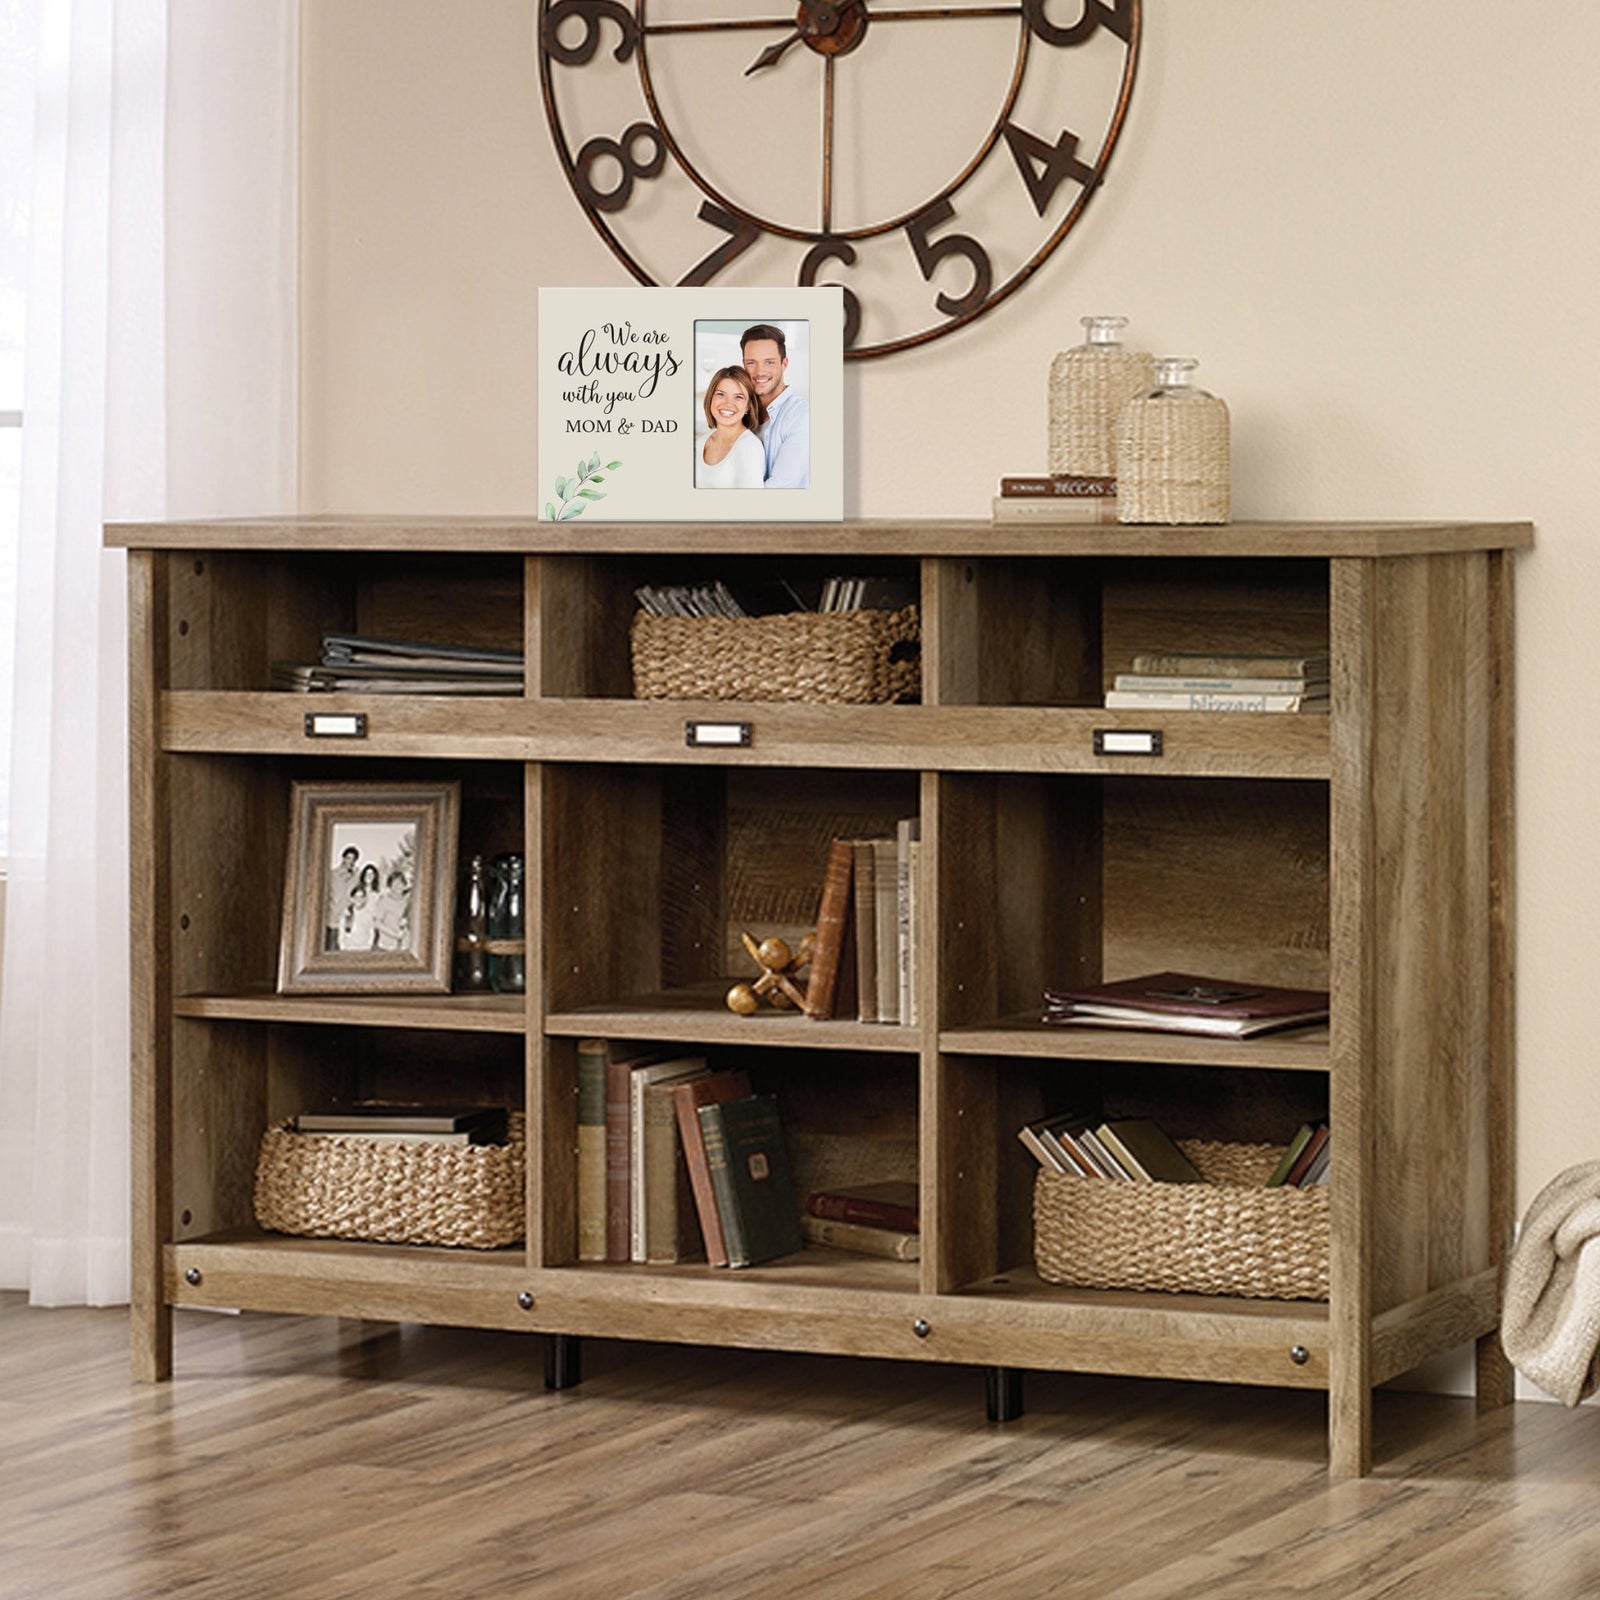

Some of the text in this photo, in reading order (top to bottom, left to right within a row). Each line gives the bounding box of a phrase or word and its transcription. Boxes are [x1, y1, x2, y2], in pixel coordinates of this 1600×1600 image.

[575, 122, 667, 212] 8
[1002, 119, 1104, 216] 4
[676, 199, 761, 287] 7
[906, 195, 992, 315] 5
[558, 329, 683, 398] always
[601, 321, 670, 346] We are
[562, 380, 636, 414] with you
[565, 417, 678, 435] MOM & DAD
